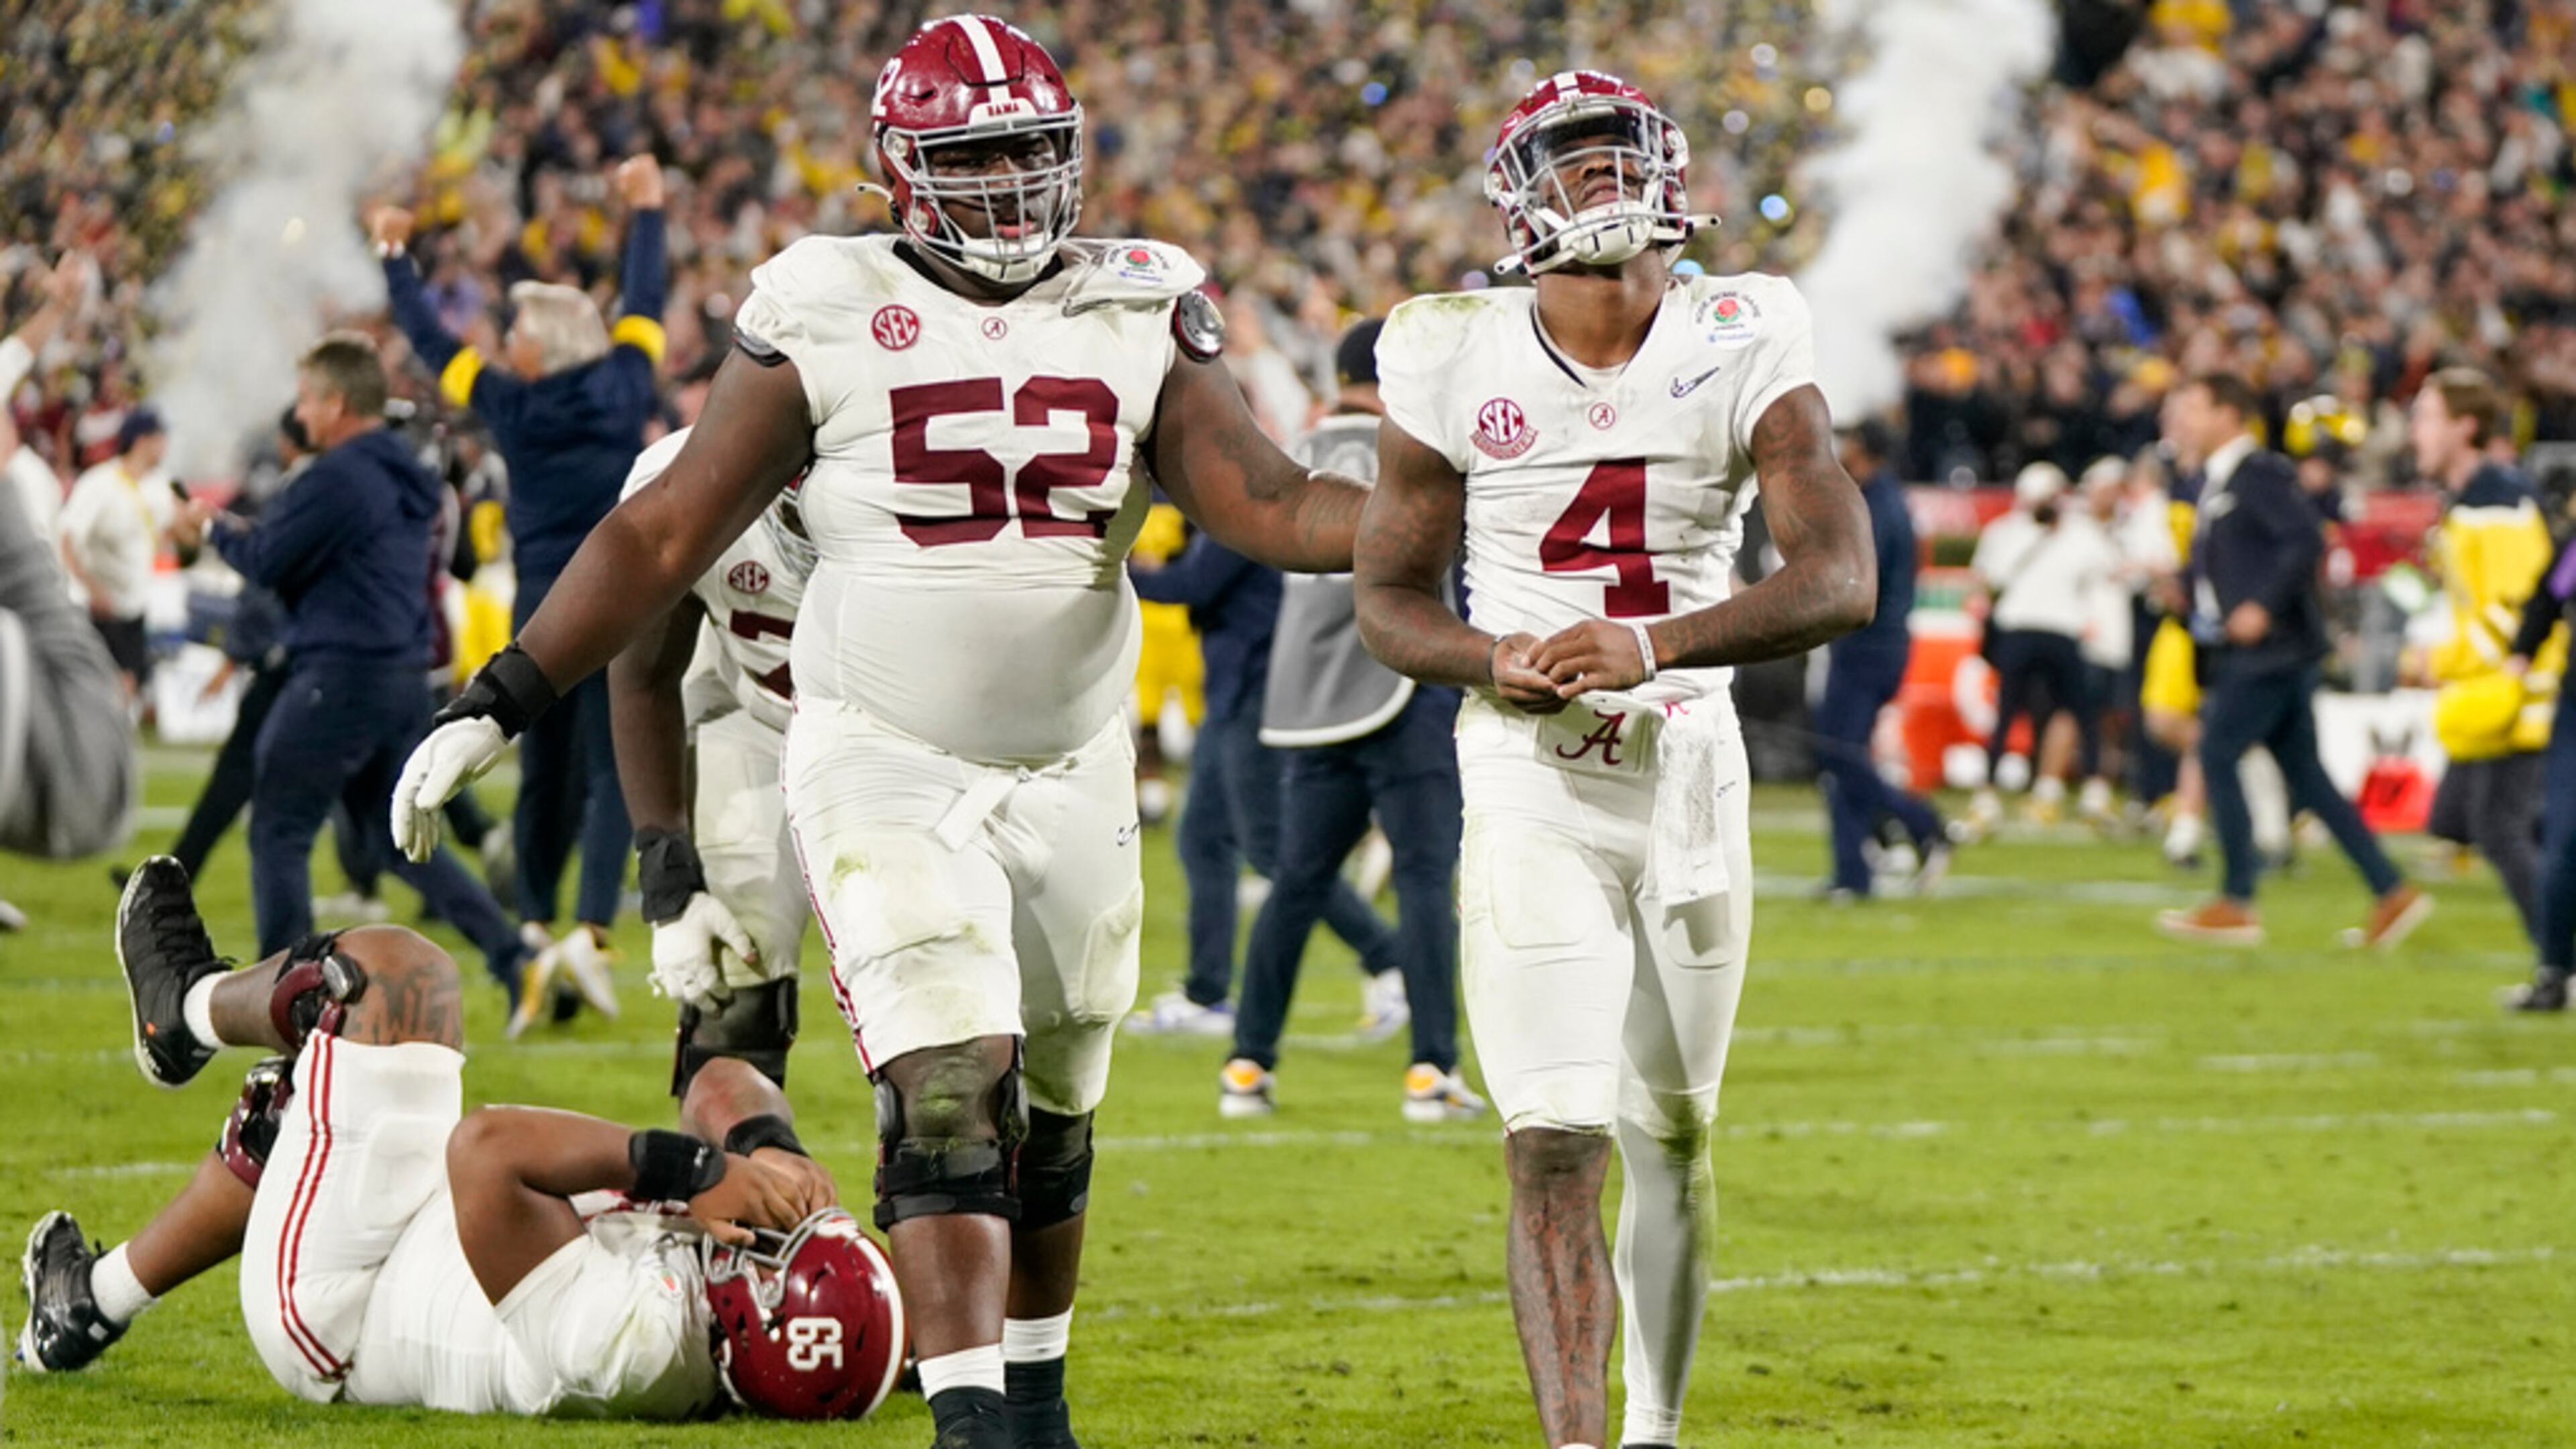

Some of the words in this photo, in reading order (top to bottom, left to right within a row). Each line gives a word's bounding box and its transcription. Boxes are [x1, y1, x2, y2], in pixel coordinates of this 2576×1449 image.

[987, 103, 1019, 117] BAMA
[874, 309, 916, 347] SEC
[1481, 402, 1521, 443] SEC
[890, 374, 1119, 547] 52
[1539, 457, 1670, 618] 4
[731, 563, 767, 592] SEC
[1556, 708, 1626, 765] A
[786, 1317, 843, 1371] 65
